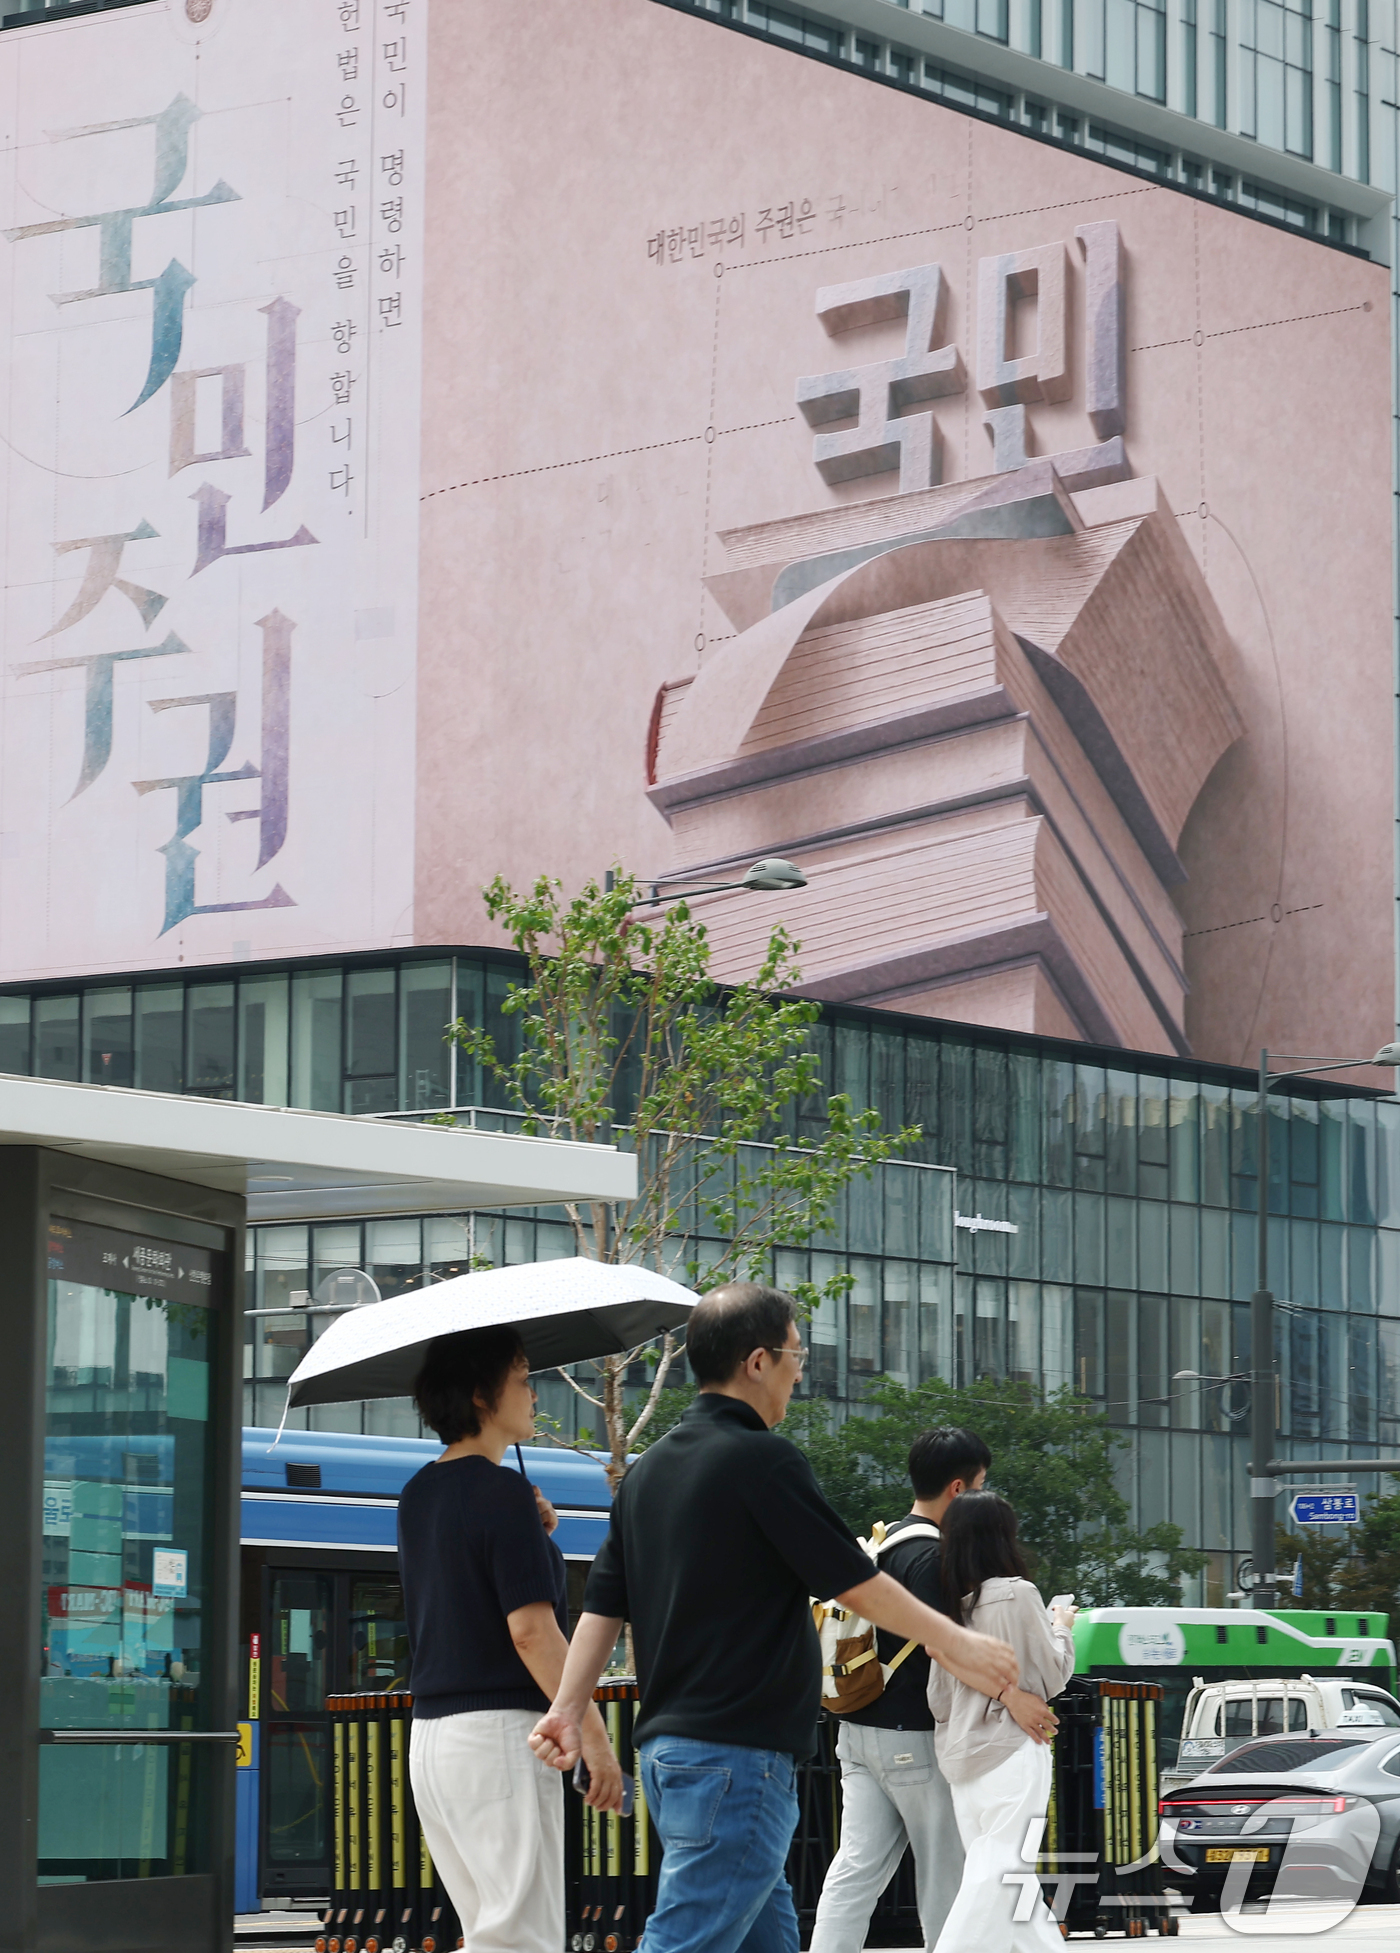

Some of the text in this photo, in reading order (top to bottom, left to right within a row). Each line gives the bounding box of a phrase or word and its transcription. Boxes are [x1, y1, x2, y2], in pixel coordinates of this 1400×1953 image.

[335, 0, 361, 128] 헌법은
[332, 158, 361, 290] 국민을
[377, 0, 411, 329] 국민이 명령하면
[646, 212, 746, 266] 대한민국의
[754, 197, 817, 245] 주권은
